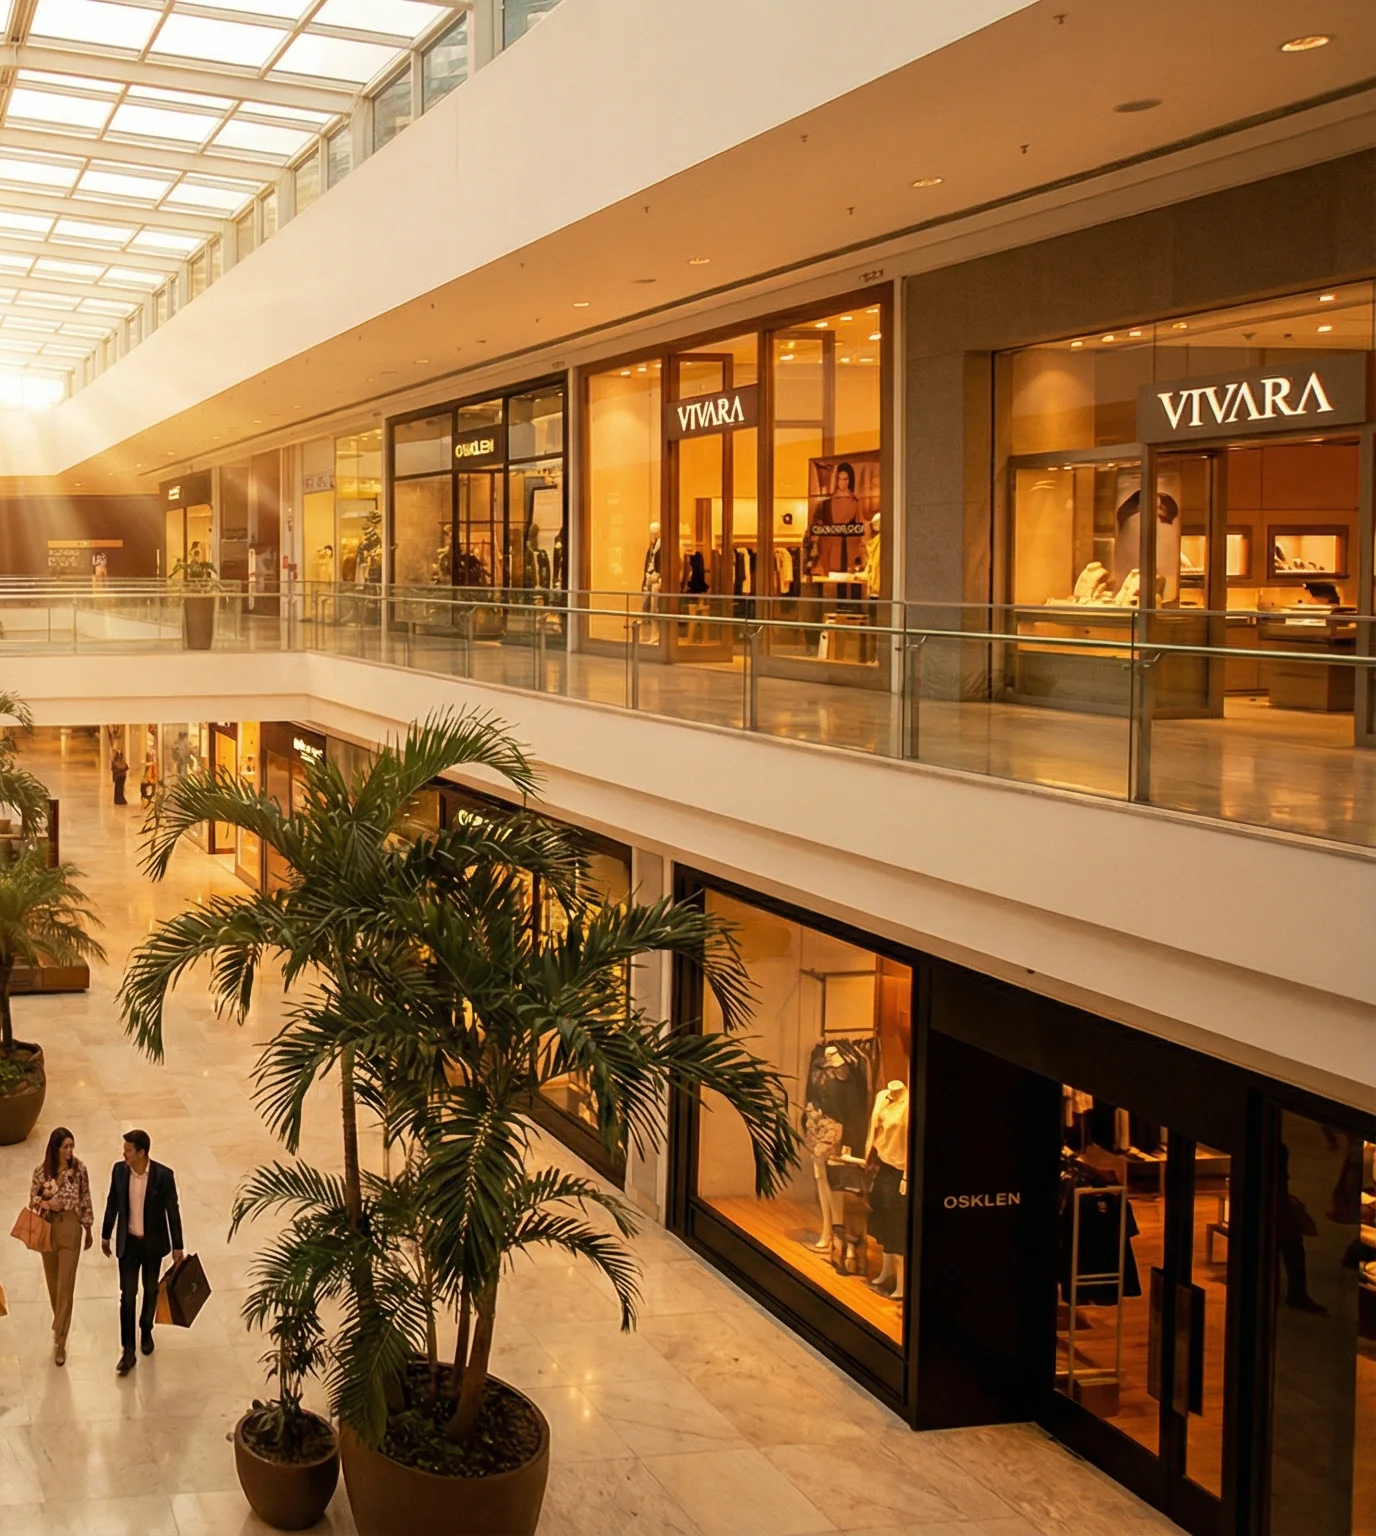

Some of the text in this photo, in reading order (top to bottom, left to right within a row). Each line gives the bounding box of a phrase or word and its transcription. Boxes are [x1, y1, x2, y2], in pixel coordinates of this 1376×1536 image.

[677, 395, 745, 432] VIVARA
[1157, 371, 1335, 430] VIVARA
[943, 1191, 1021, 1209] OSKLEN
